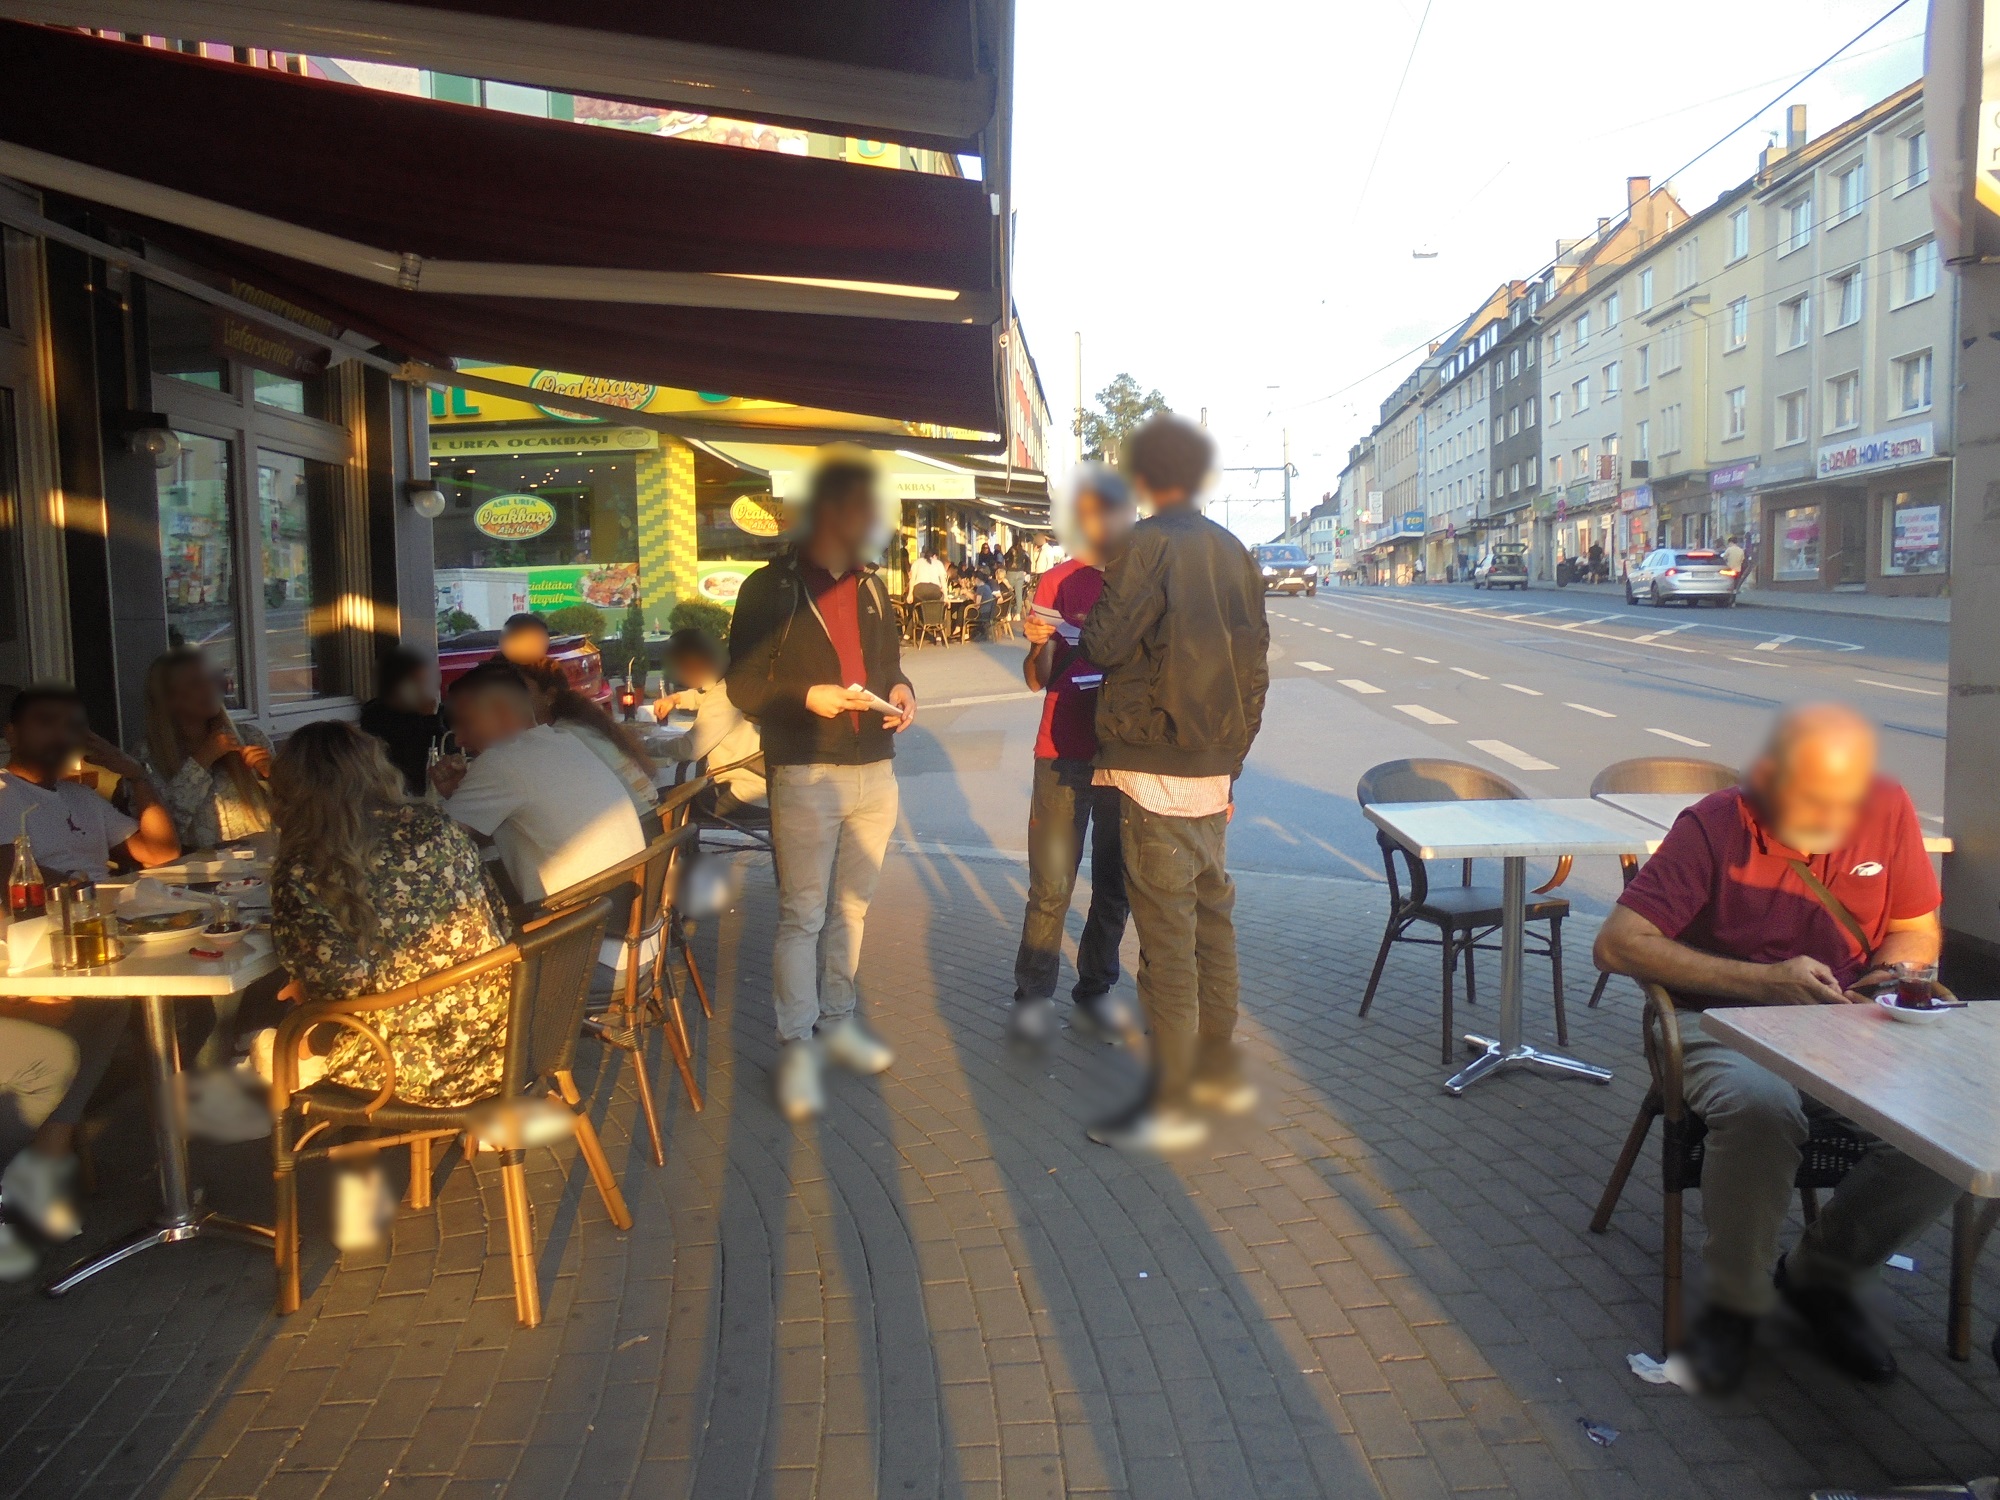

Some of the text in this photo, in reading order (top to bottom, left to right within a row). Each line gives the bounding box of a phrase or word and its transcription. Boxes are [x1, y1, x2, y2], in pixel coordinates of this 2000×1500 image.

[449, 439, 499, 450] URFA
[507, 435, 608, 447] OCAKBAŞI
[1860, 441, 1889, 464] HOME
[897, 482, 936, 494] AKBAŞI
